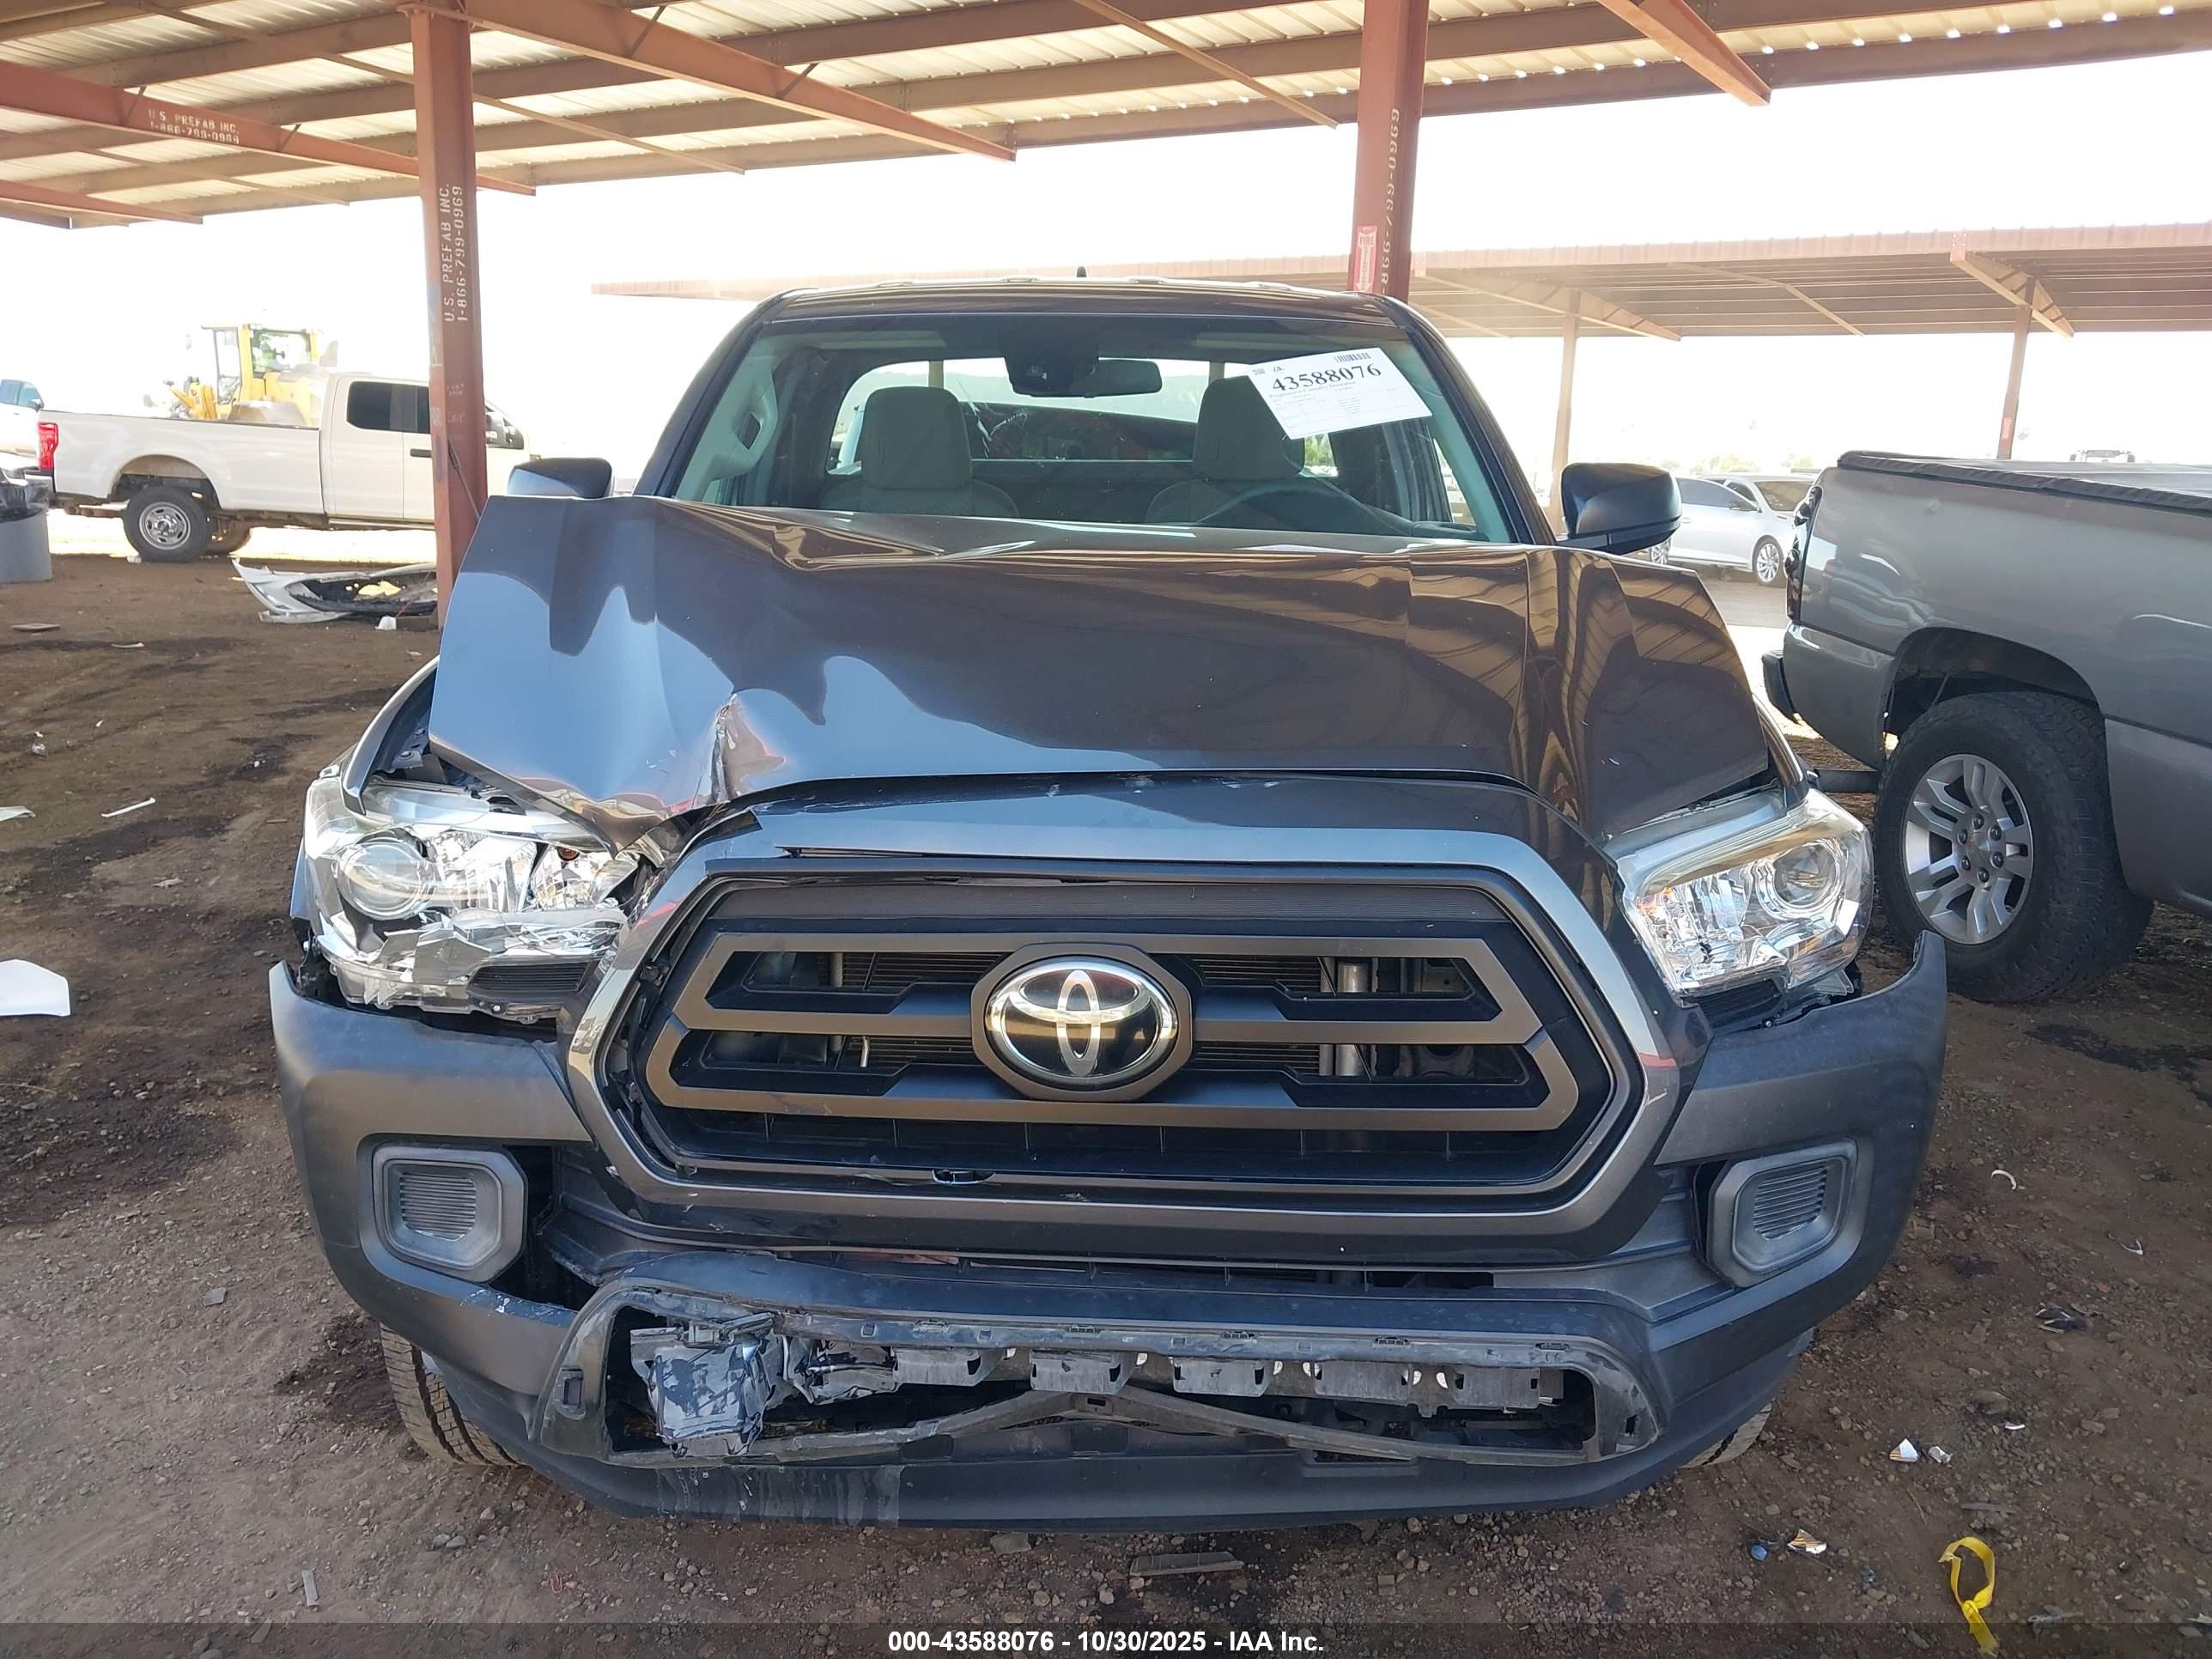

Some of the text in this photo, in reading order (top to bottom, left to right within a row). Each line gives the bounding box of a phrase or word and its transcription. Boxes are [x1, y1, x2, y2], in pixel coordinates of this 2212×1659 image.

[149, 109, 240, 134] US. PREFAB INC.
[439, 184, 455, 321] U.S. PREFAB INC.
[452, 185, 468, 321] 1-866-799-0969
[1359, 235, 1375, 246] FIRE
[1273, 363, 1381, 391] 43588076
